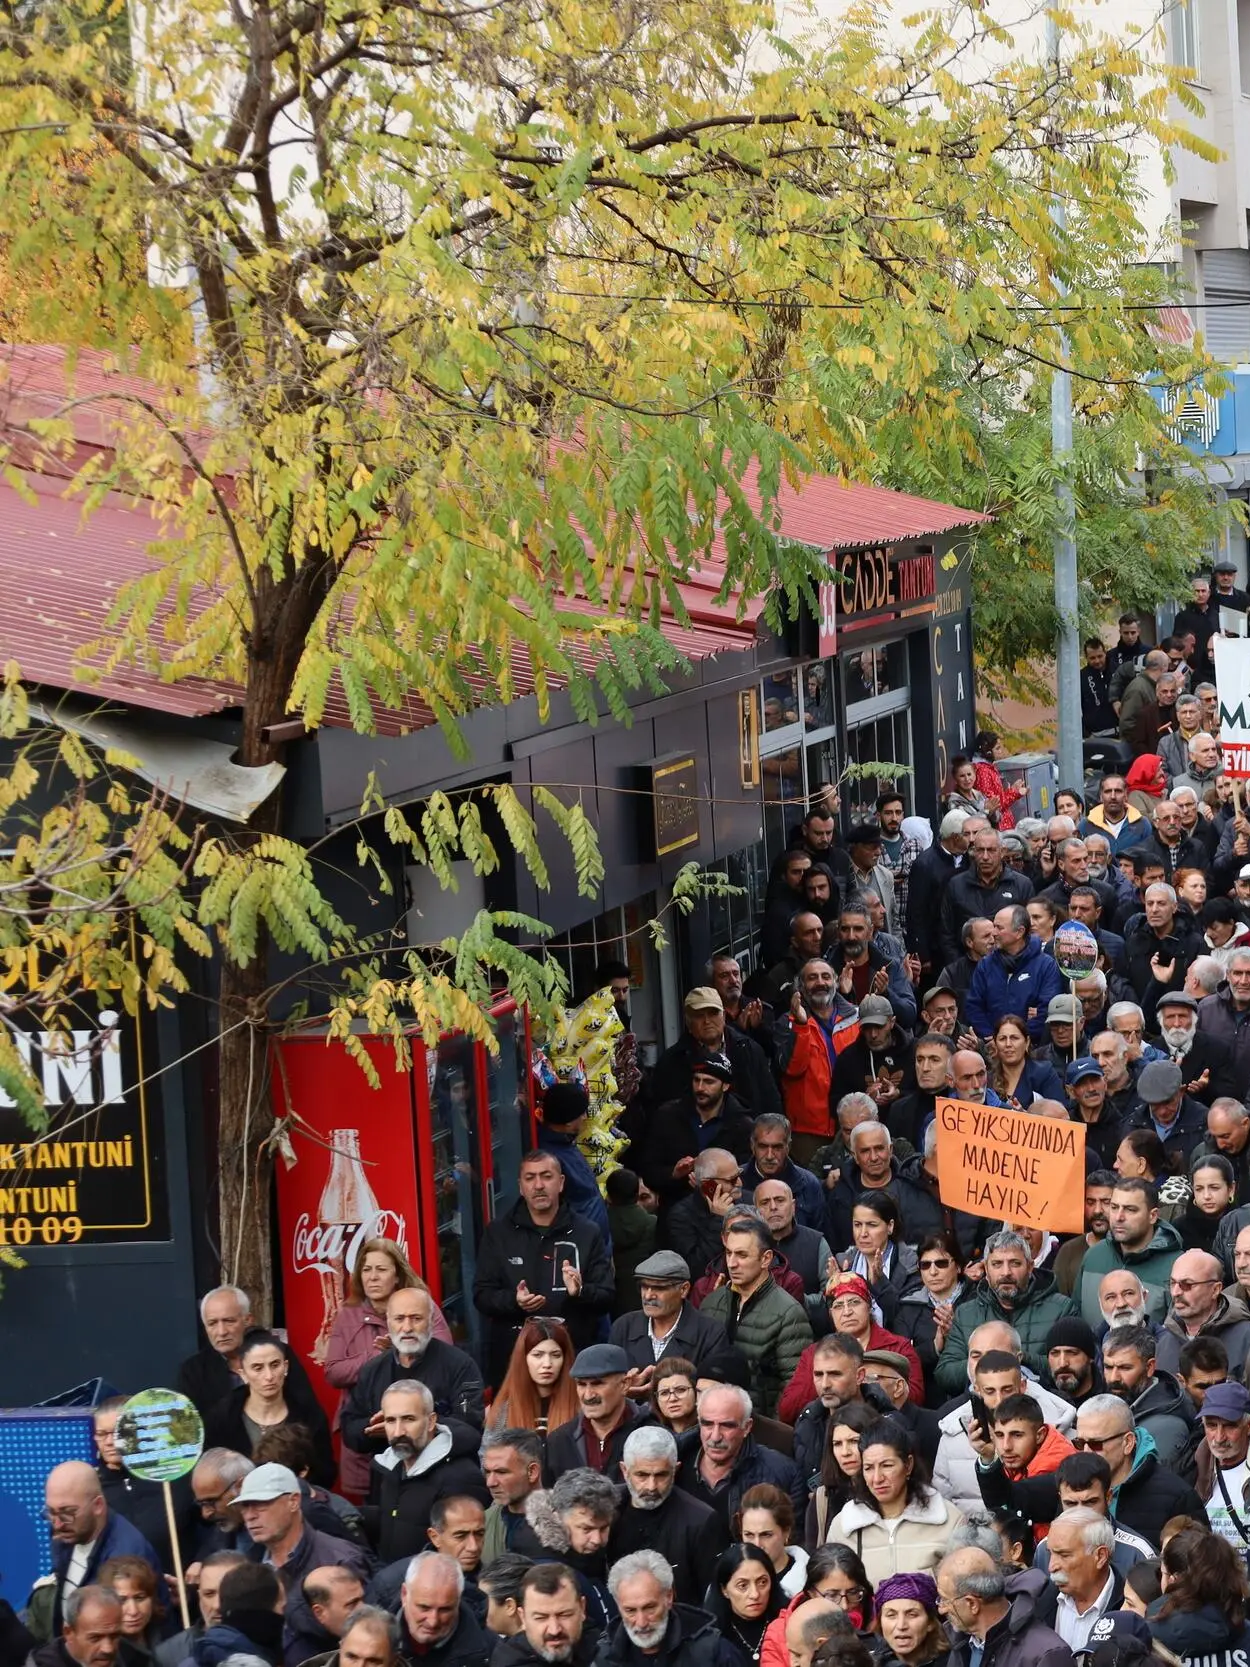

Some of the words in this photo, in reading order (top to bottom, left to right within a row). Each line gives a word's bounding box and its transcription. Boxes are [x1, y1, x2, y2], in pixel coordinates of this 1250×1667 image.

[942, 1104, 1076, 1157] GEYİKSUYUNDA
[24, 1135, 134, 1169] TANTUNİ
[963, 1142, 1041, 1185] MADENE
[42, 1217, 83, 1243] 09
